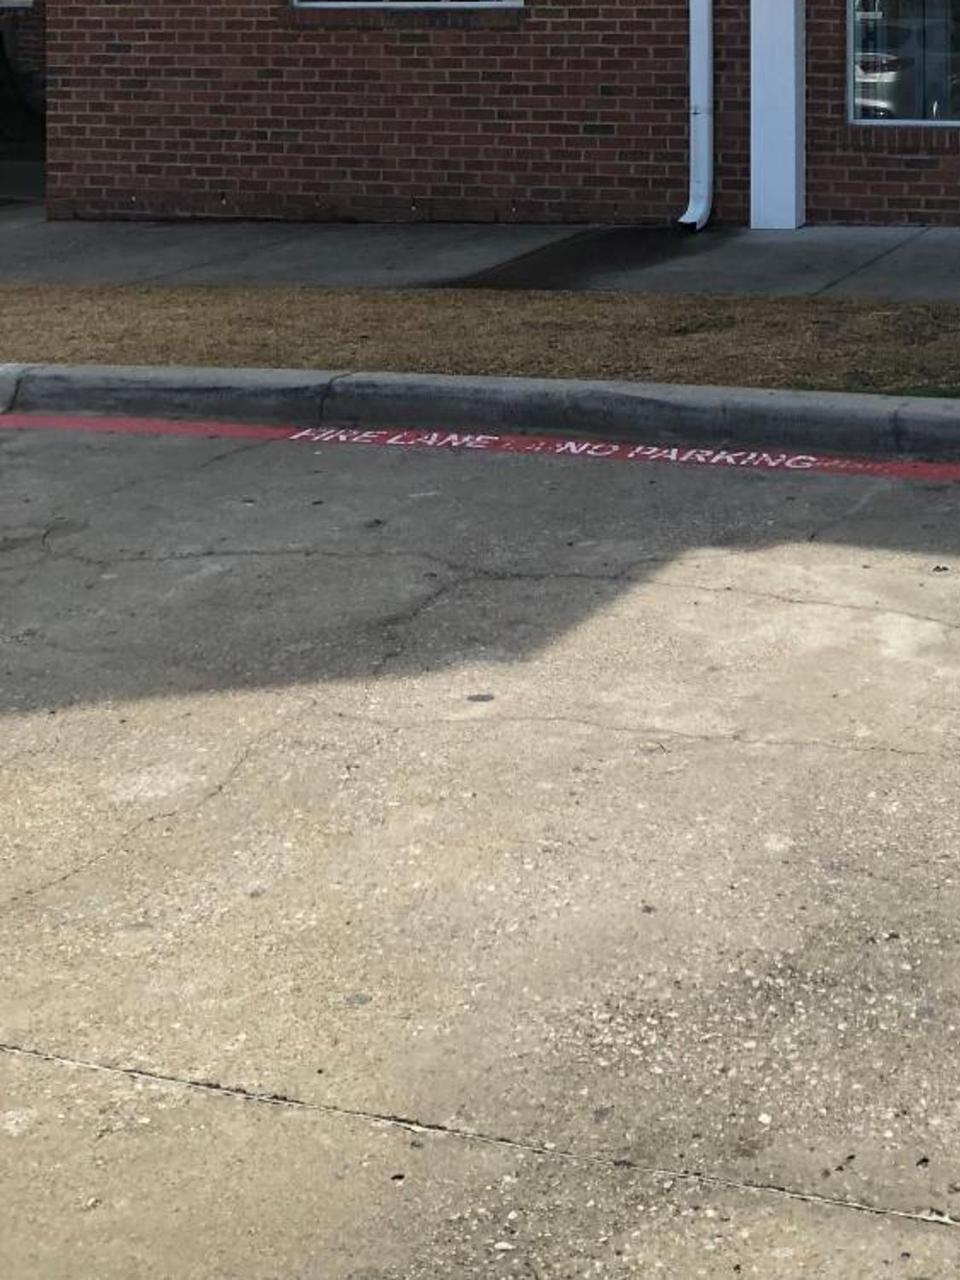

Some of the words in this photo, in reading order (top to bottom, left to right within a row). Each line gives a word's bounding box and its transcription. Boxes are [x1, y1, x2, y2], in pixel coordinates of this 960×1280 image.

[386, 431, 499, 448] LANE
[555, 441, 619, 456] NO
[627, 445, 817, 469] PARKING
